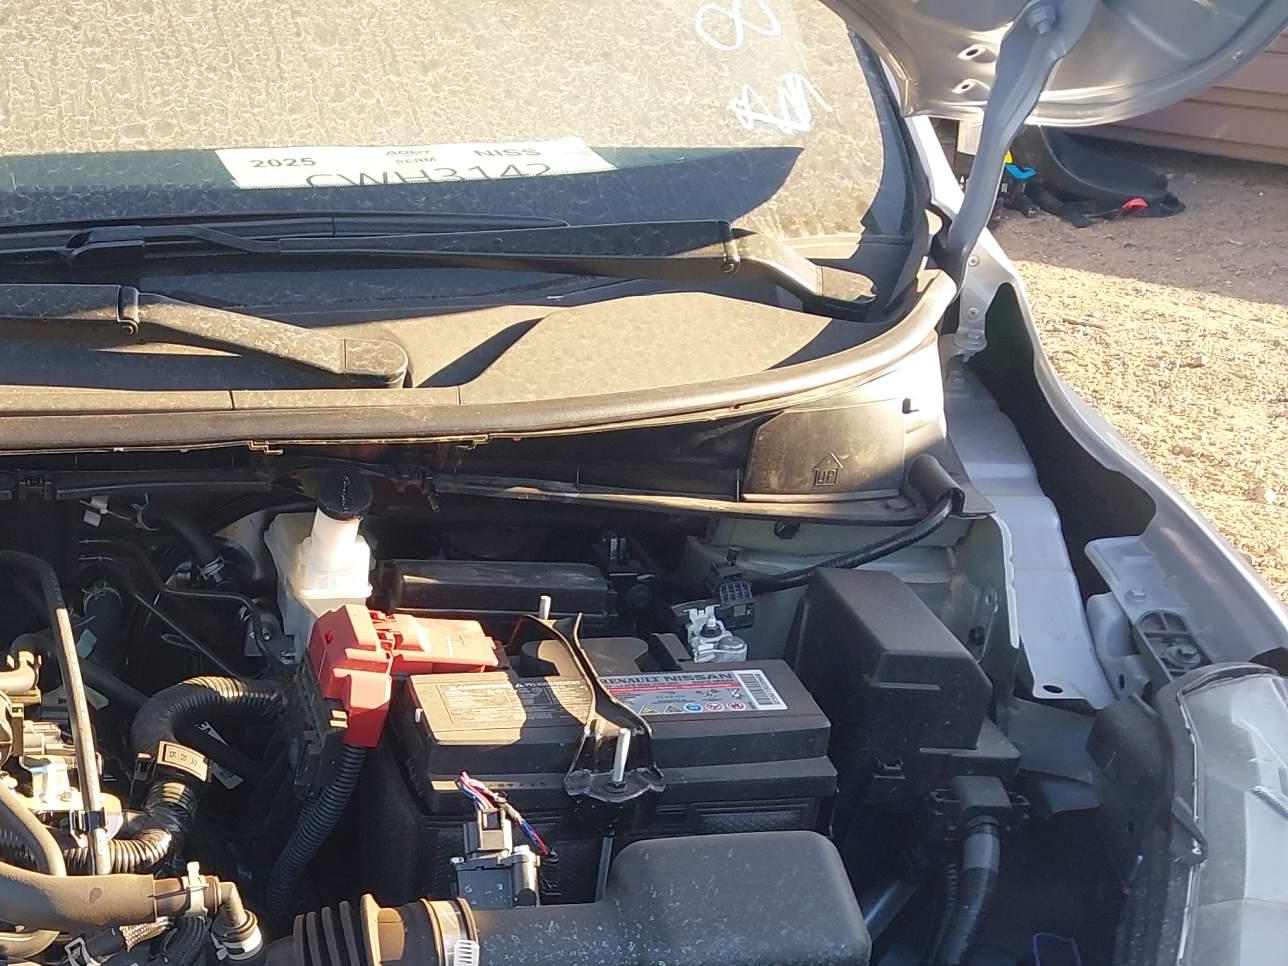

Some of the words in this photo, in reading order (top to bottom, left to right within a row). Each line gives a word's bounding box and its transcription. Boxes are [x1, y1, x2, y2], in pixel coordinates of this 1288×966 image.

[474, 148, 541, 158] NISS
[249, 156, 317, 168] 2025
[818, 471, 835, 484] UP
[663, 672, 733, 682] NISSAN
